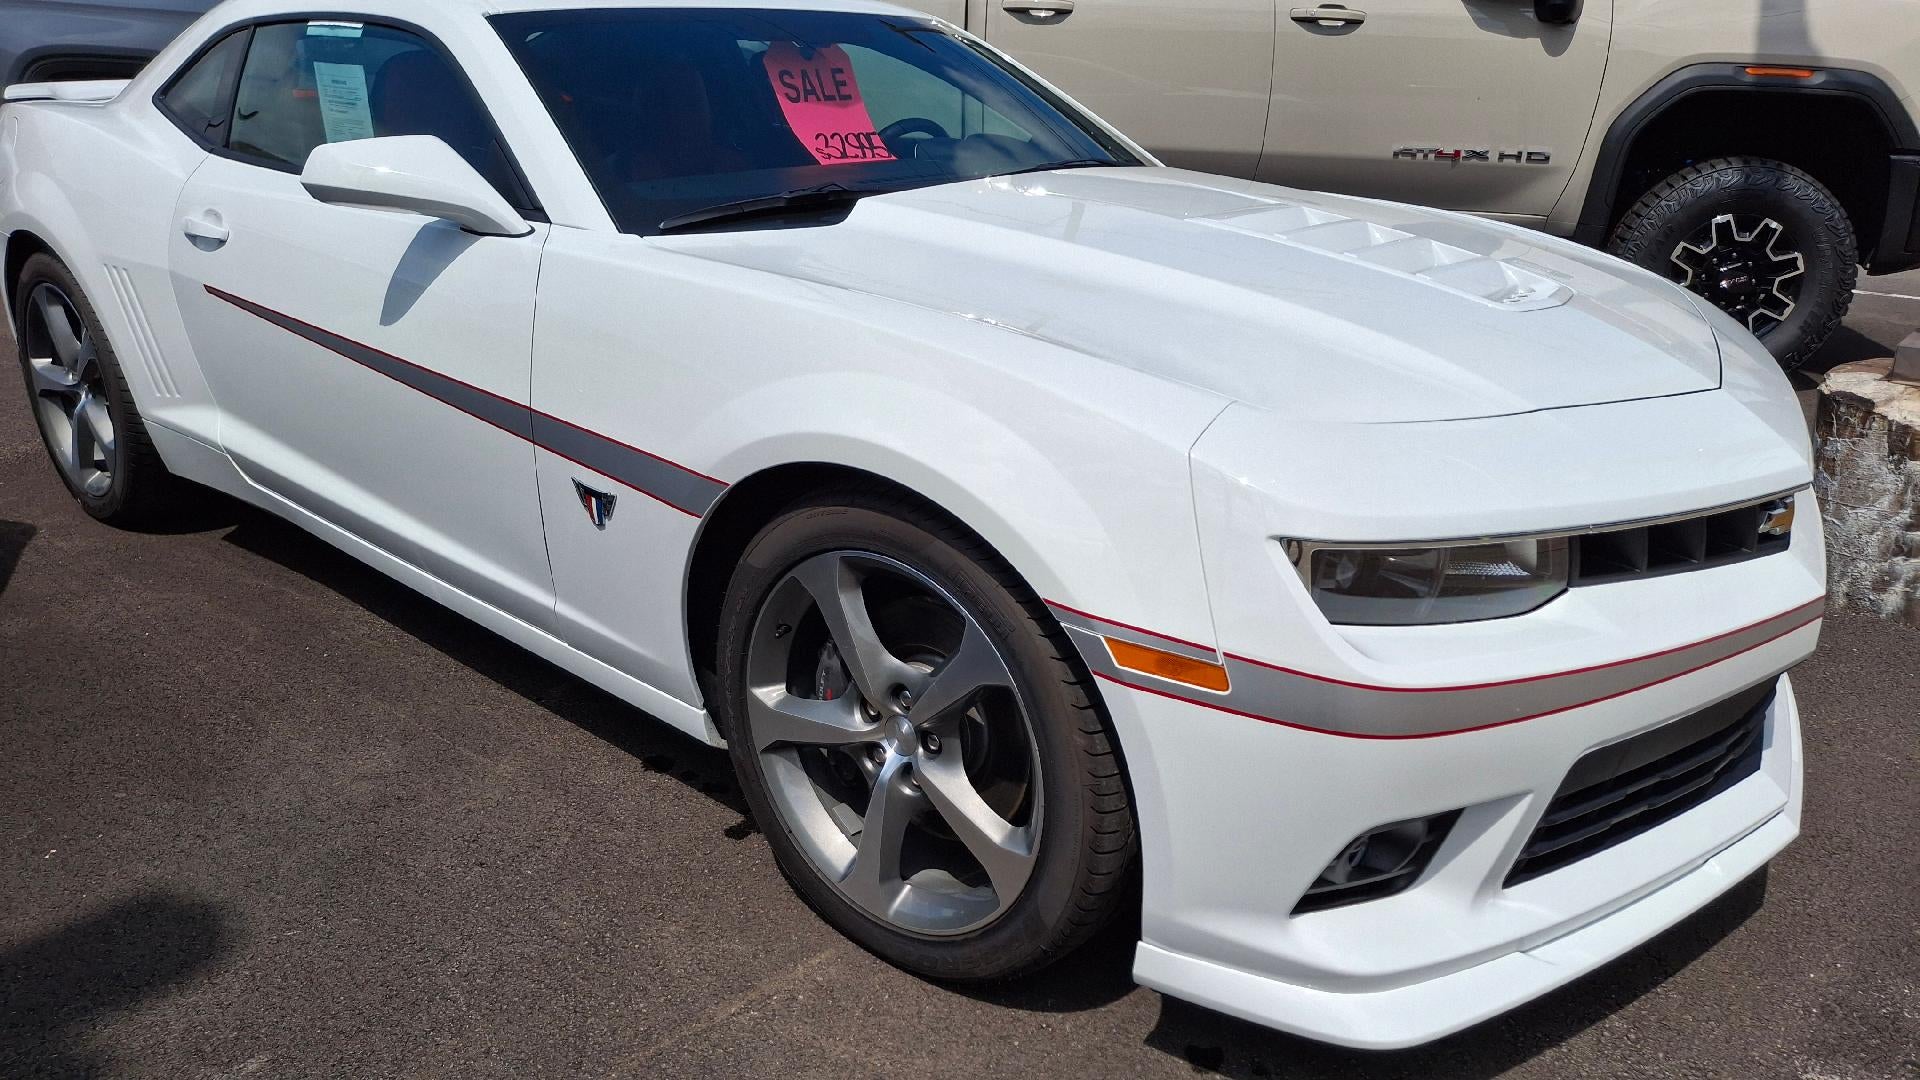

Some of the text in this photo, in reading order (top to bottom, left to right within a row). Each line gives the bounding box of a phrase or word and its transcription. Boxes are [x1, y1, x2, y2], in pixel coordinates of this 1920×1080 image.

[778, 68, 852, 103] SALE
[1393, 148, 1550, 165] AT4X HD
